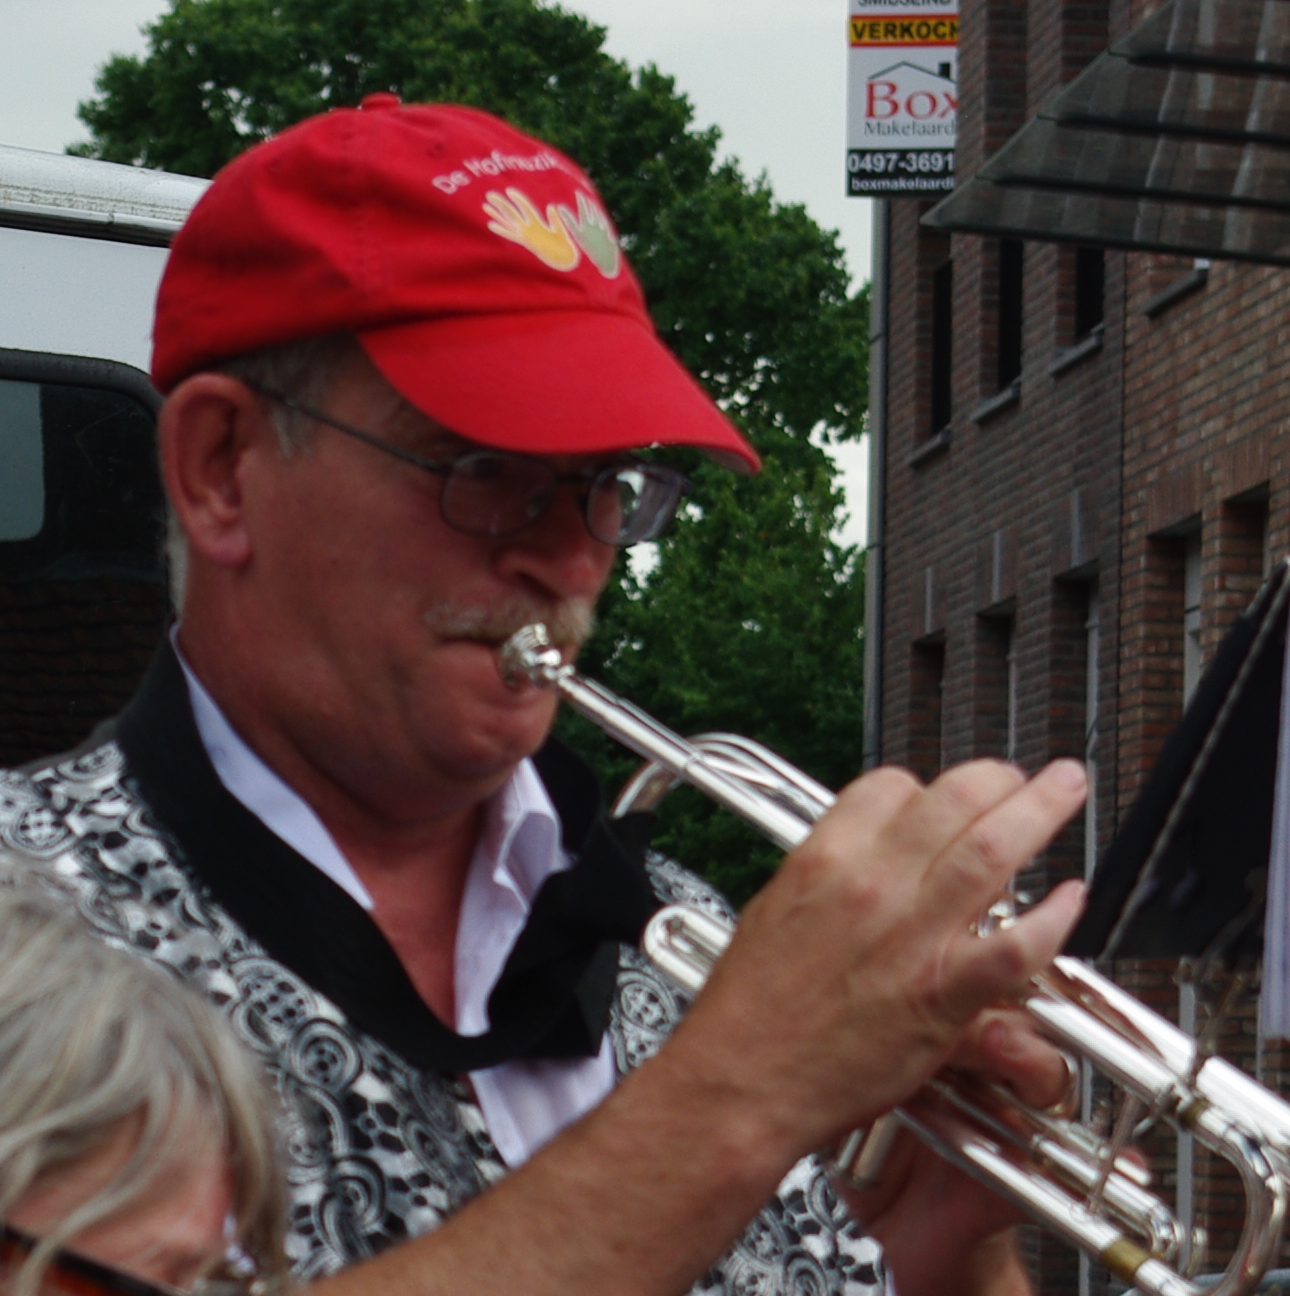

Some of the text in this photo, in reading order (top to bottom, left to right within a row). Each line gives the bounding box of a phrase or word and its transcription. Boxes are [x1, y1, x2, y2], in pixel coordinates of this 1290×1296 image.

[864, 80, 958, 119] Box
[847, 152, 955, 172] 0497-3691
[431, 169, 471, 195] De
